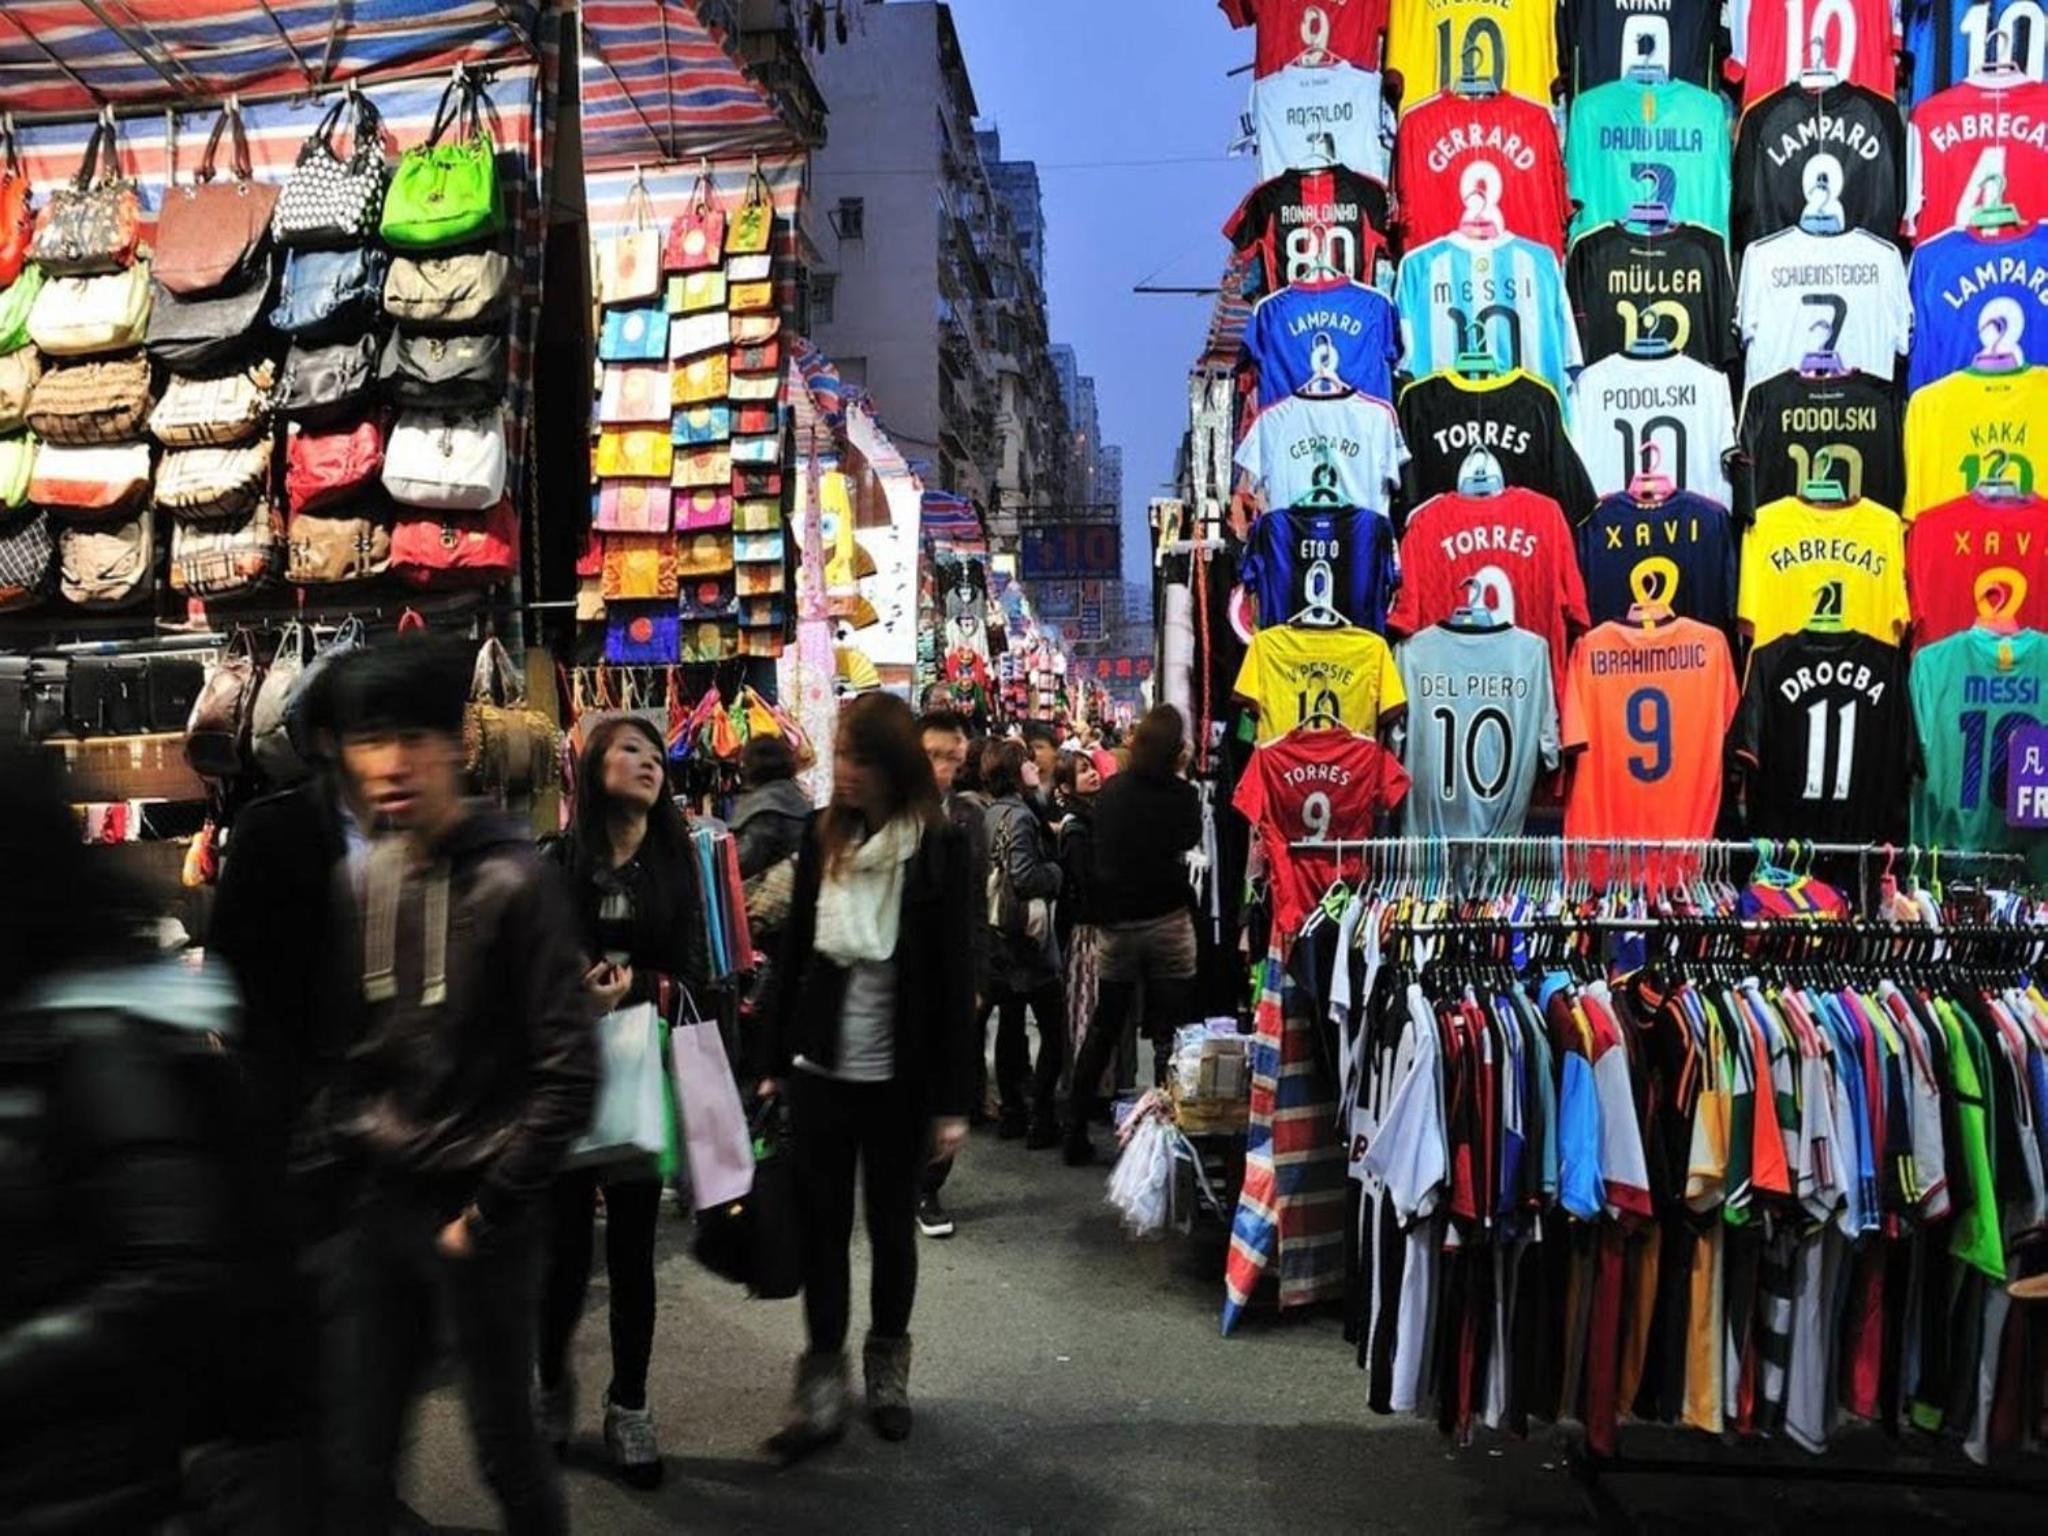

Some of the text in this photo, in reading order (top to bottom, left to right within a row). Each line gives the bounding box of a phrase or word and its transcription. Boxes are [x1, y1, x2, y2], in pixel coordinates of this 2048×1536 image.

[1428, 123, 1536, 173] GERRARD
[1600, 128, 1703, 151] DAVID VILLA
[1768, 116, 1880, 166] LAMPARD
[1929, 113, 2048, 152] FABREGA
[1281, 204, 1358, 224] RONALDINHO
[1286, 226, 1354, 282] 80
[1434, 278, 1531, 303] MESSI
[1608, 264, 1701, 293] MÜLLER
[1771, 264, 1879, 288] SCHWEINSTEIGER
[1288, 311, 1362, 336] LAMPARD
[1801, 293, 1847, 352] 7
[1603, 384, 1696, 410] PODOLSKI
[1433, 421, 1531, 454] TORRES
[1441, 525, 1538, 561] TORRES
[1605, 518, 1699, 549] XAVI
[1954, 530, 2048, 556] XAV
[1770, 539, 1887, 577] FABREGAS
[1591, 644, 1706, 675] IBRAHIMOVIC
[1420, 675, 1527, 699] DEL PIERO
[1780, 661, 1885, 705] DROGBA
[1963, 675, 2040, 704] MESSI
[1626, 687, 1672, 782] 9
[1802, 698, 1856, 800] 11
[1433, 705, 1514, 801] 10
[1284, 764, 1350, 787] TORRES
[1302, 791, 1331, 843] 9
